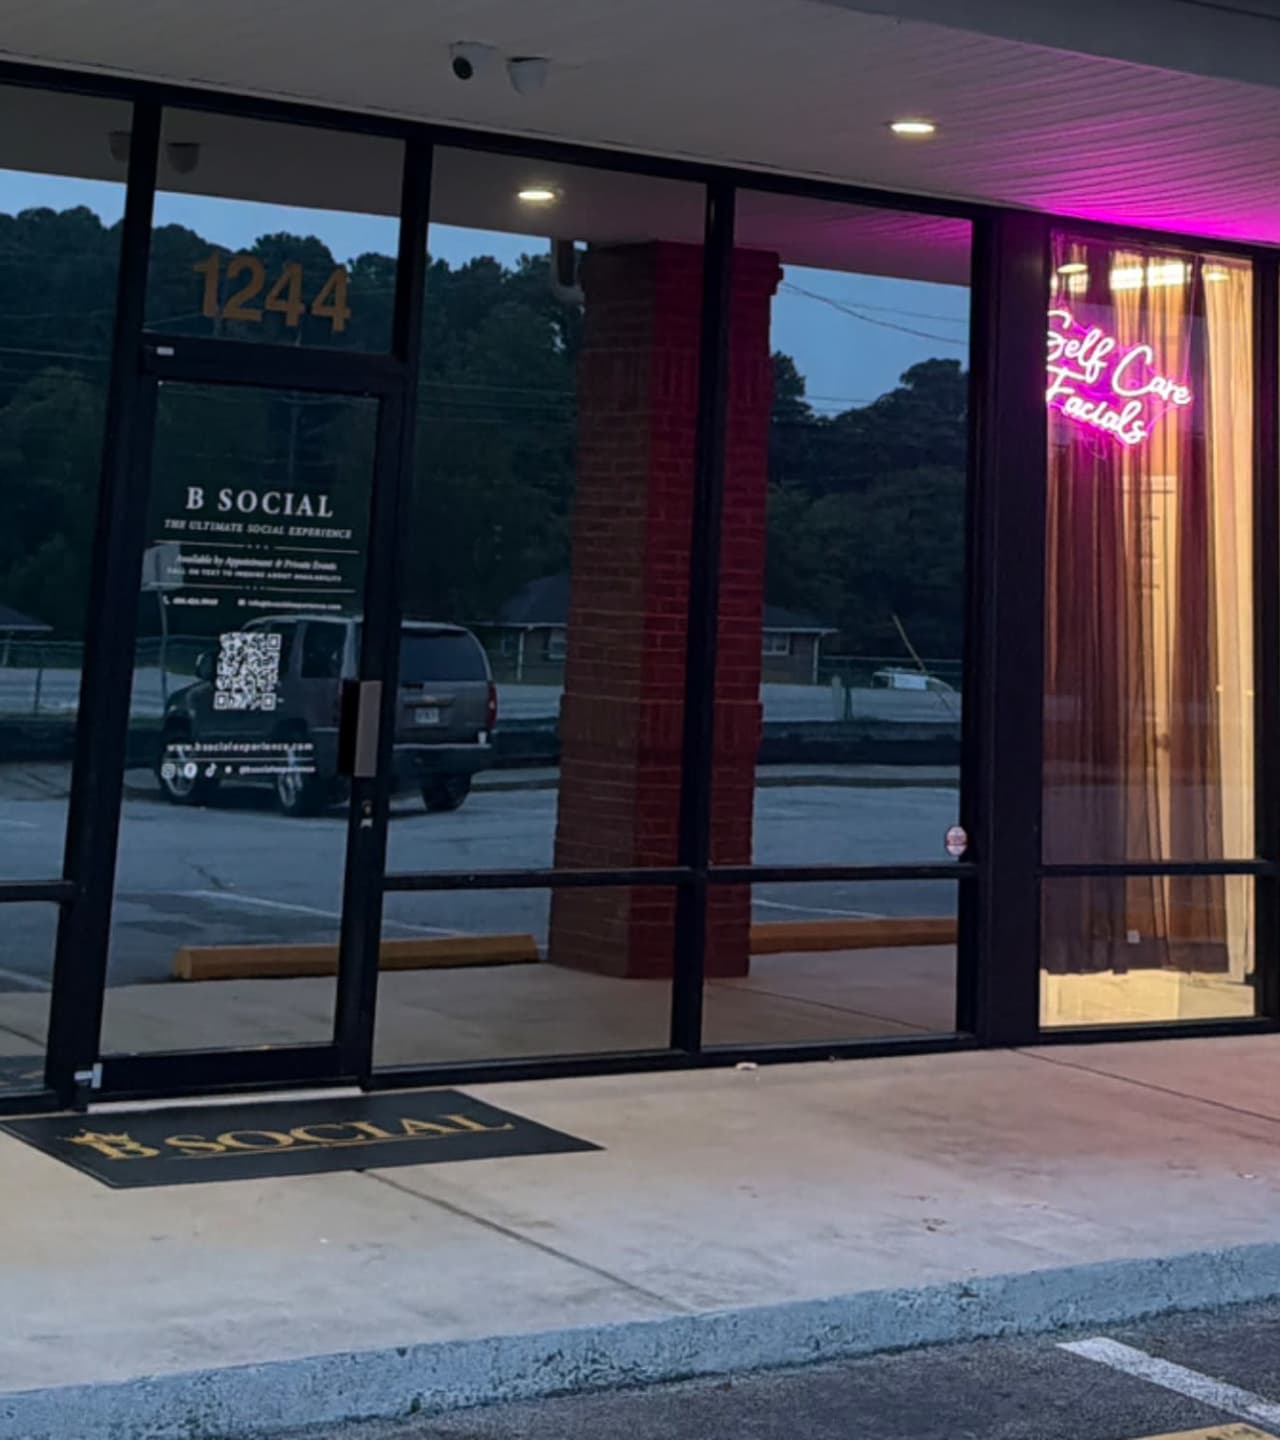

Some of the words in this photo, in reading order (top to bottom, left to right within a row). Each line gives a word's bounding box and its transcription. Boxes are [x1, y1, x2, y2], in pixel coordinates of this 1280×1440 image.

[193, 252, 352, 332] 1244
[1047, 309, 1116, 384] Self
[1111, 345, 1192, 405] Care
[1046, 364, 1148, 445] Facials
[164, 518, 186, 530] THE
[188, 520, 243, 534] ULTIMATE
[247, 523, 285, 536] SOCIAL
[288, 526, 353, 540] EXPERIENCE
[185, 486, 204, 510] B
[217, 487, 334, 518] SOCIAL
[86, 1136, 160, 1160] B
[164, 1113, 516, 1156] SOCIAL
